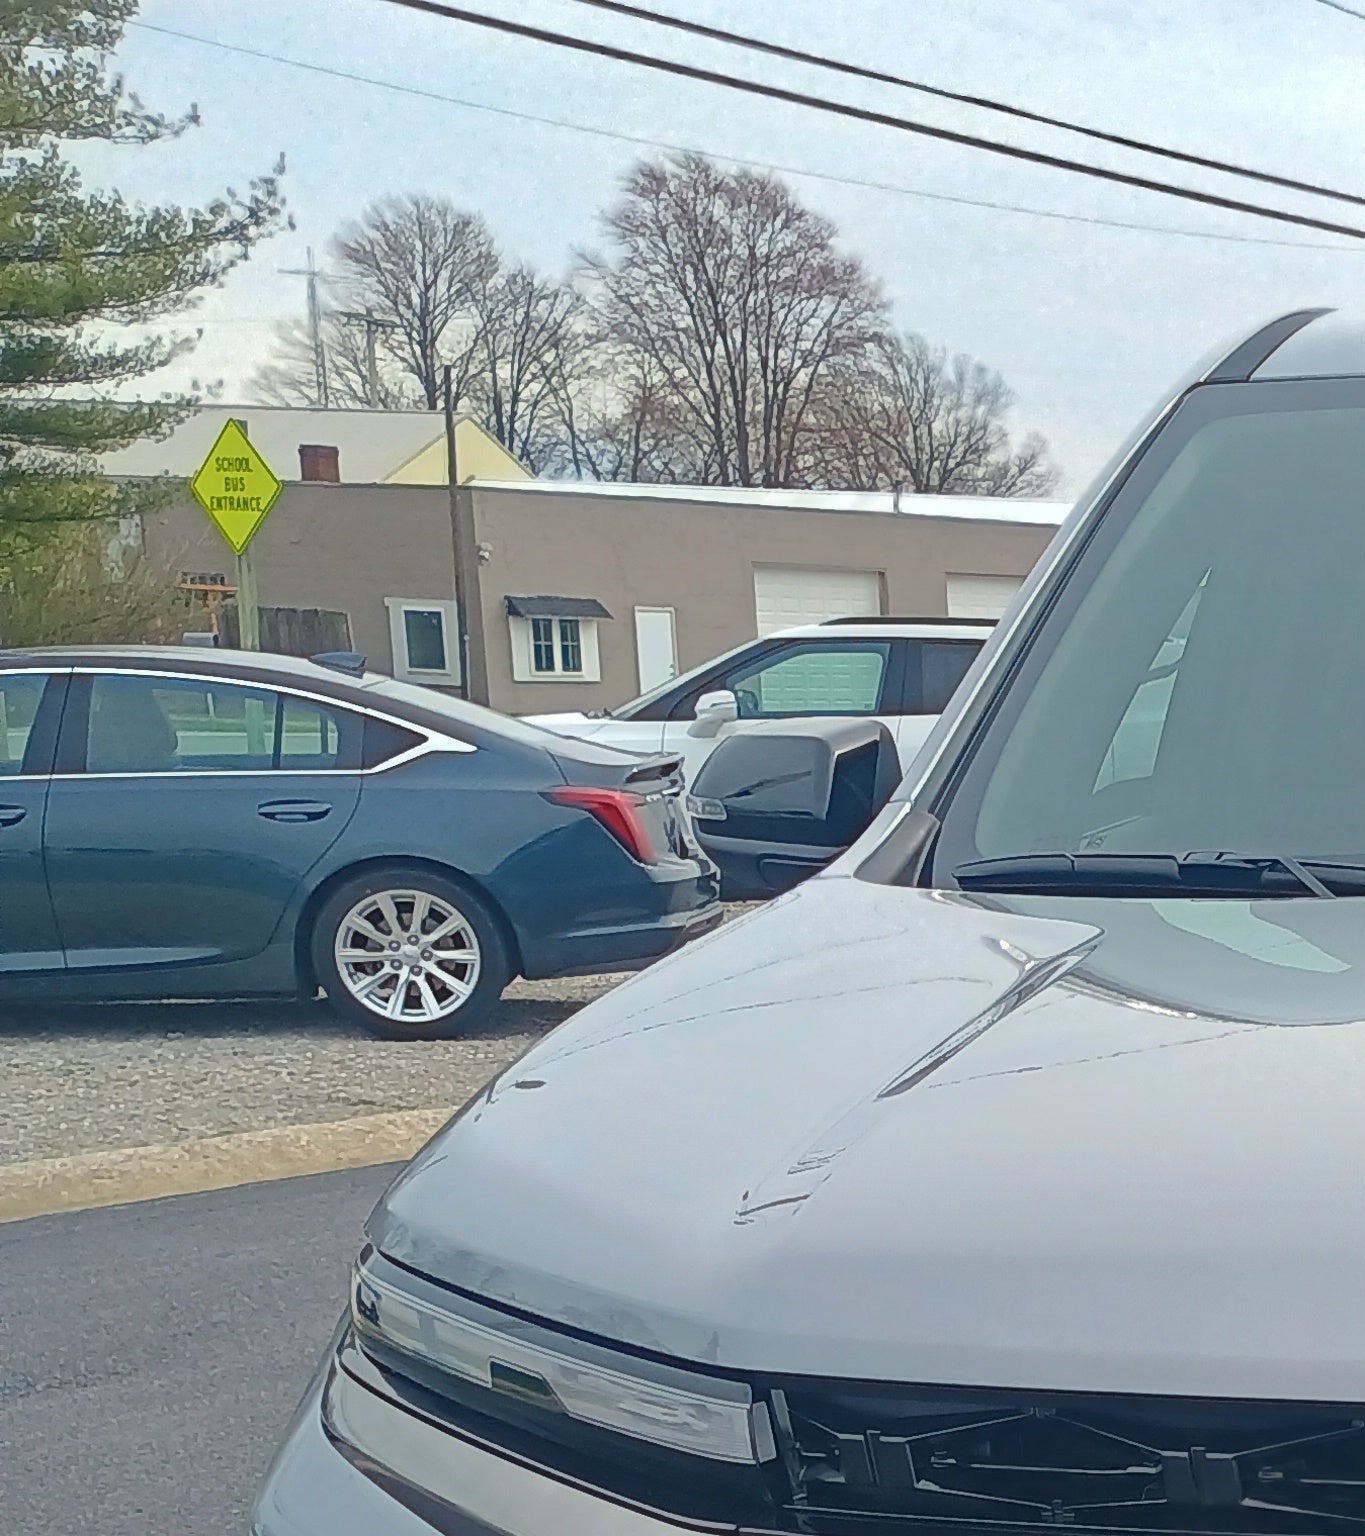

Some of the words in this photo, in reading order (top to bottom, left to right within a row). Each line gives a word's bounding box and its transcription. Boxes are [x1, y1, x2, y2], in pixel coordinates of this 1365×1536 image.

[215, 457, 253, 472] SCHOOL
[224, 476, 245, 492] BUS
[210, 496, 262, 511] ENTRANCE
